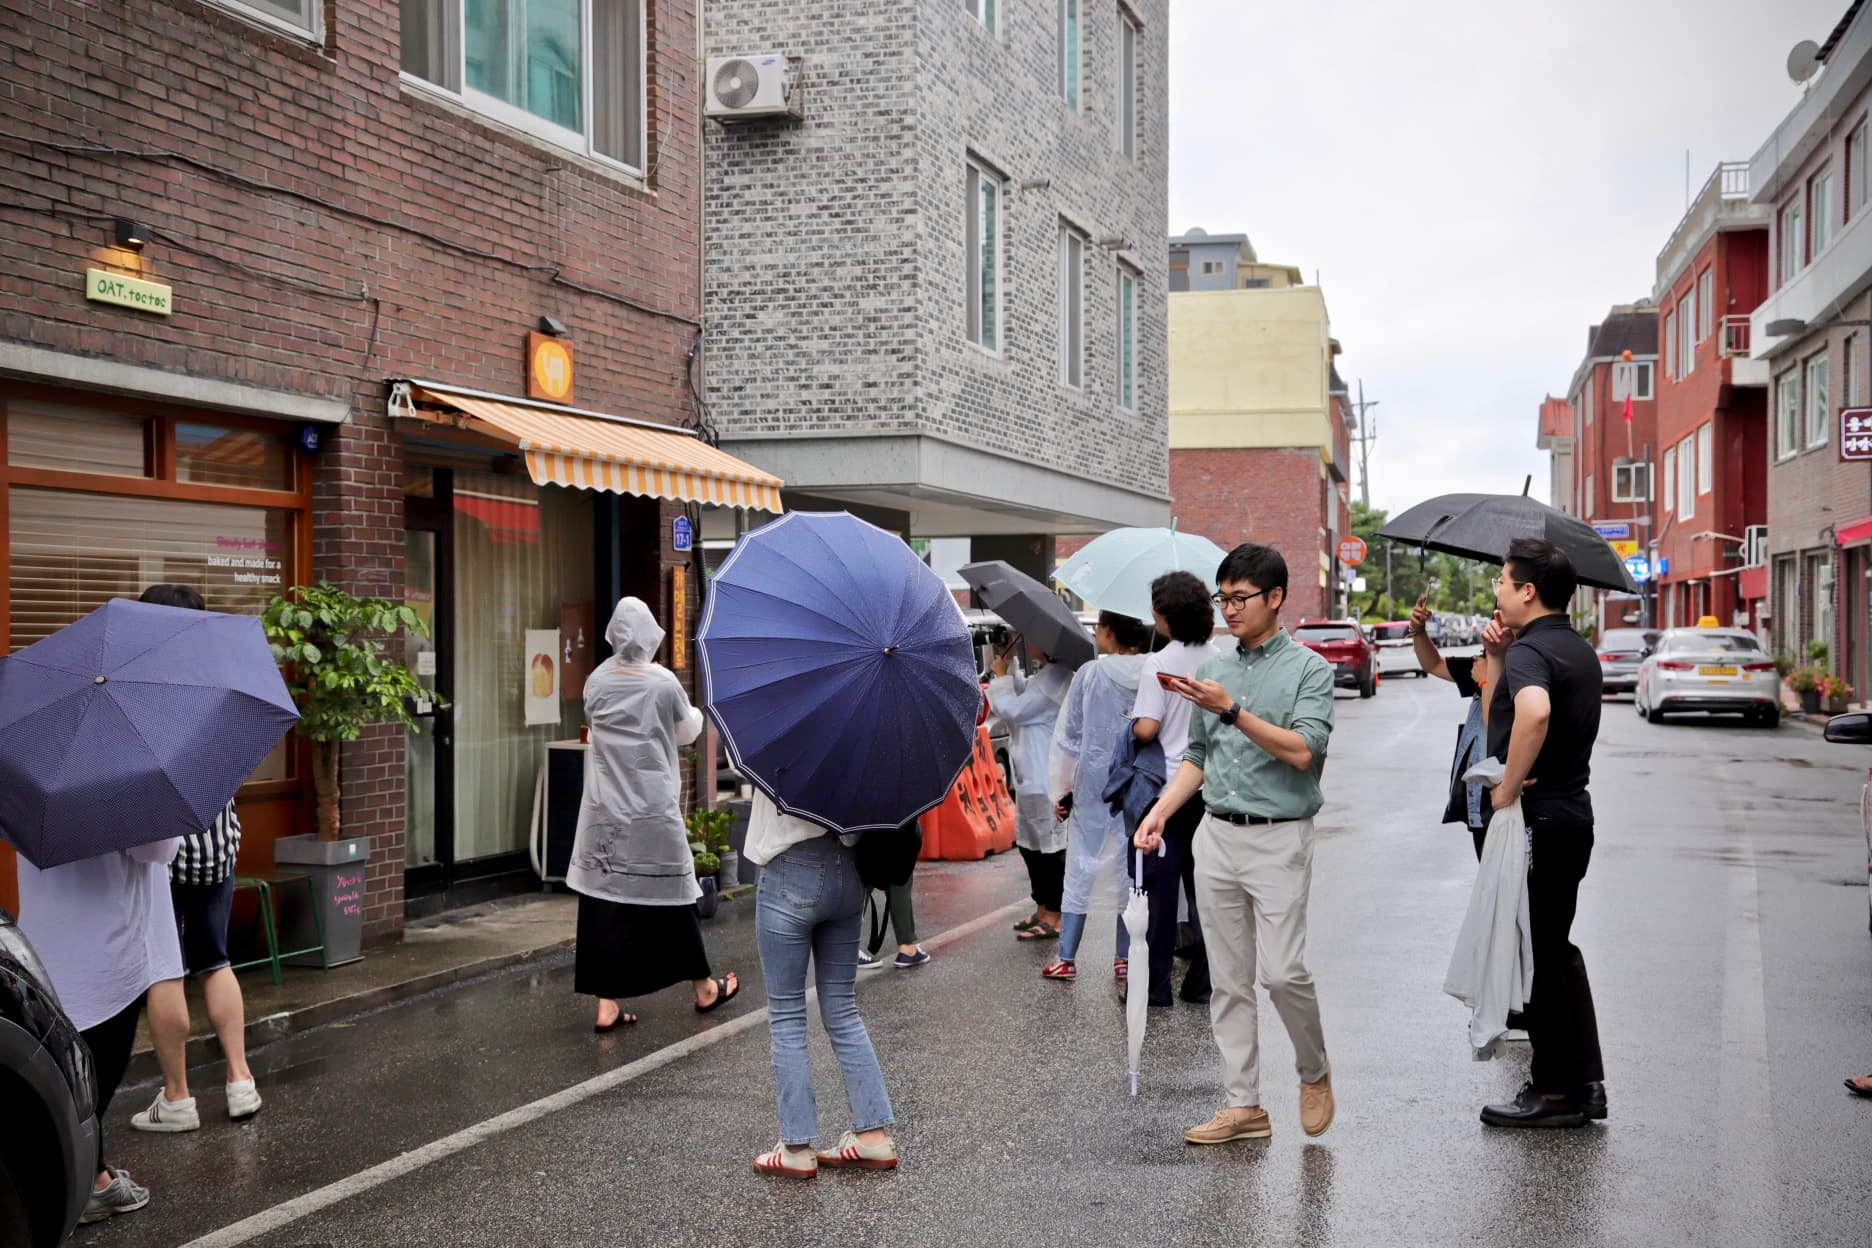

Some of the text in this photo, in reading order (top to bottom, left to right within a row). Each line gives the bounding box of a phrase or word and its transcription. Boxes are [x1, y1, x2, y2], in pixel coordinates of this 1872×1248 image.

[207, 555, 230, 566] baked
[231, 557, 244, 567] and
[245, 558, 265, 569] made
[265, 559, 276, 569] for
[234, 572, 282, 585] healthy snack
